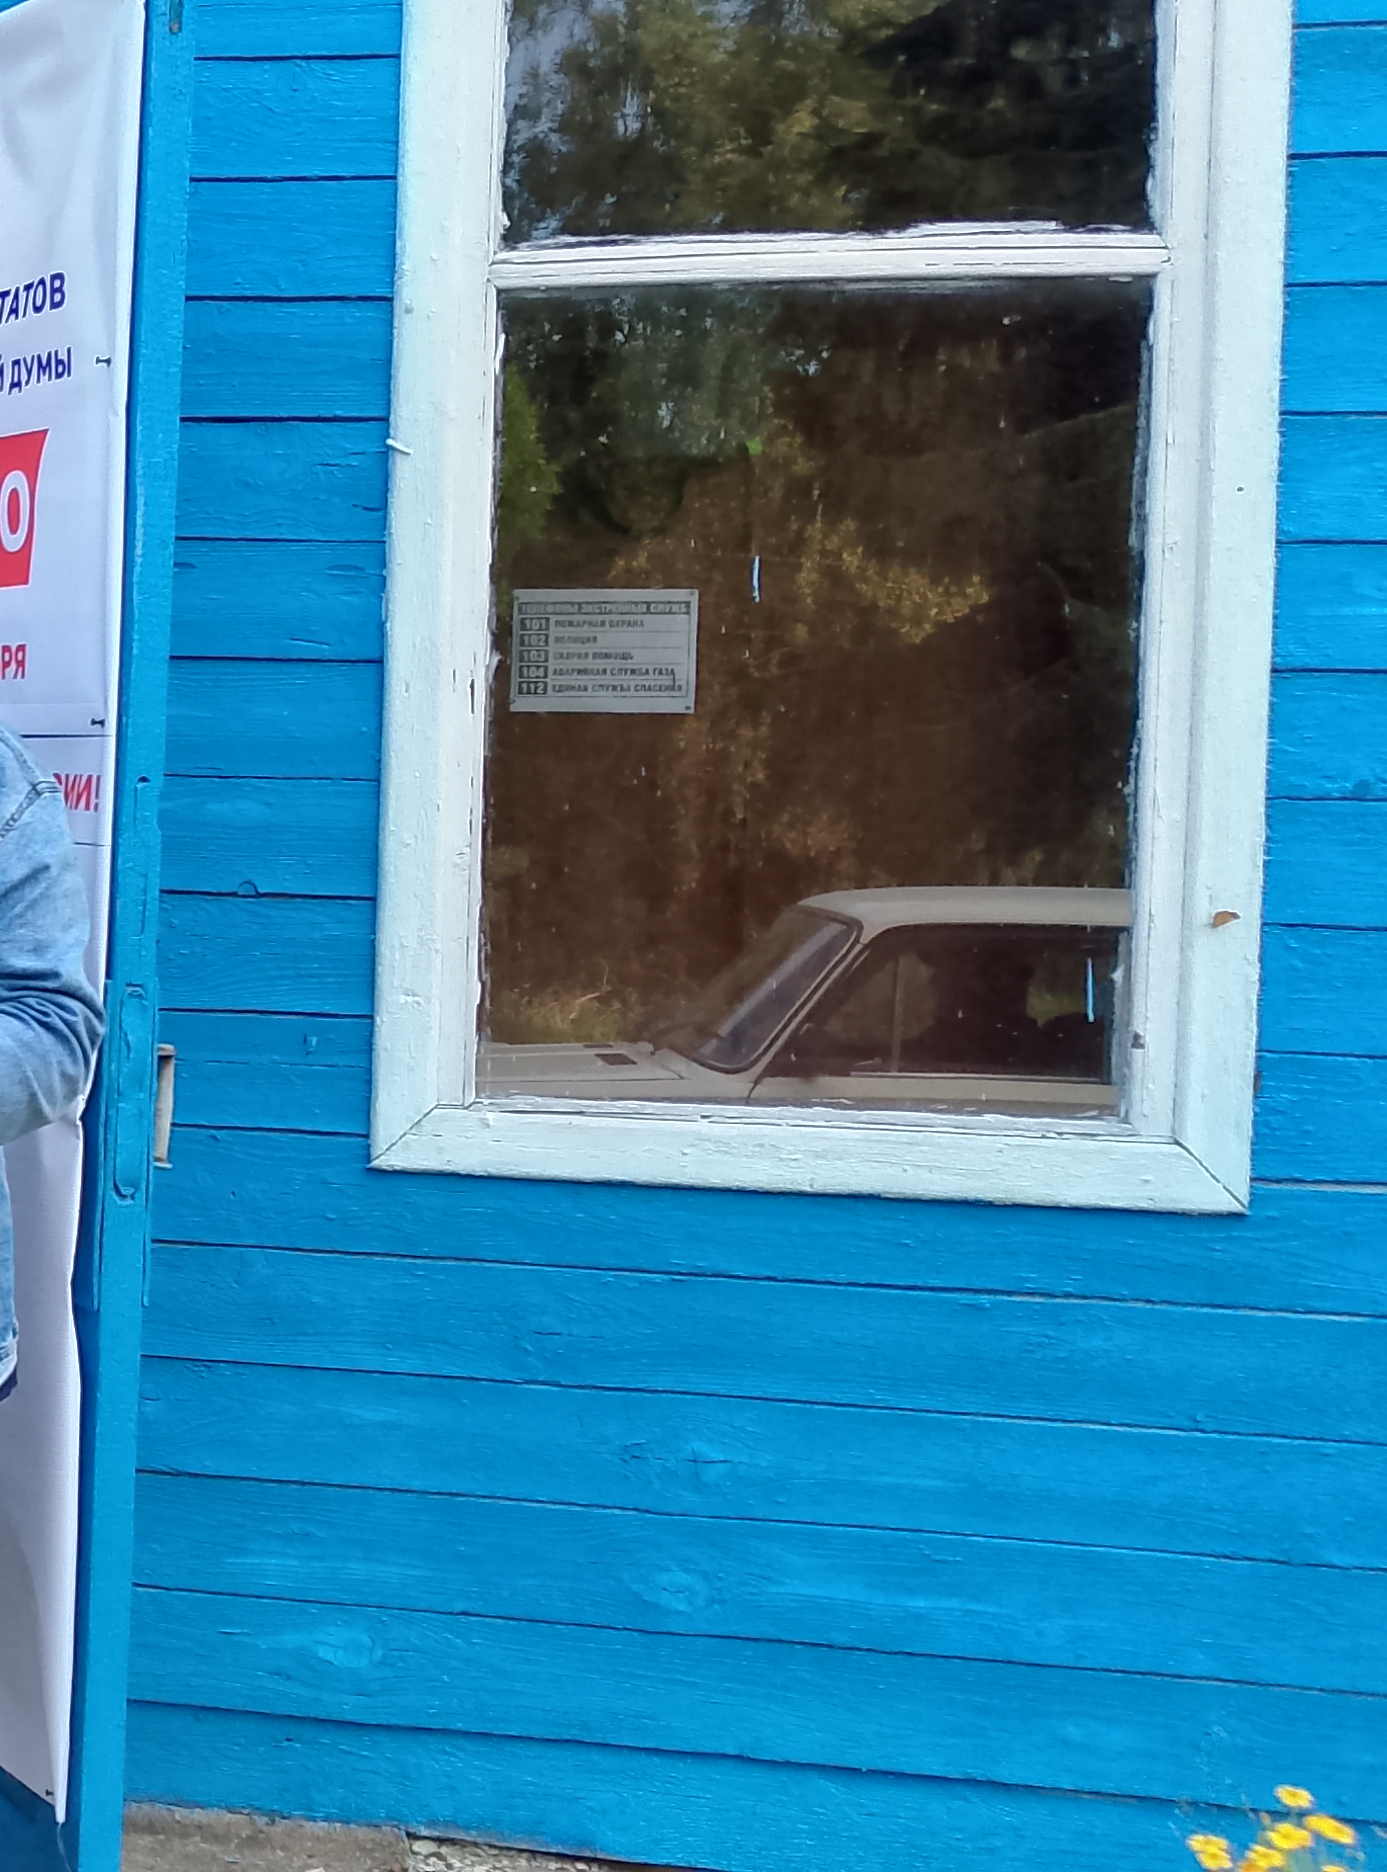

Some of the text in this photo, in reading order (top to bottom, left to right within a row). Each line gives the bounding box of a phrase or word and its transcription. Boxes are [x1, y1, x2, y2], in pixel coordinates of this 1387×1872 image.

[8, 346, 72, 395] ДУМЫ
[521, 604, 578, 614] ТЕЛЕФОНЫ
[650, 603, 687, 612] СЛУЖБ
[524, 619, 645, 630] 101 ПОЖАРНАЯ ОХРАНА
[523, 635, 546, 646] 102
[523, 651, 545, 662] 103
[592, 652, 633, 661] ПОМОЩЬ
[522, 666, 675, 677] 104 АВАРИЙНАЯ СЛУЖБА ГАЗА
[521, 683, 682, 694] 112 ЕДИНАЯ СЛУЖБА СПАСЕНИЯ
